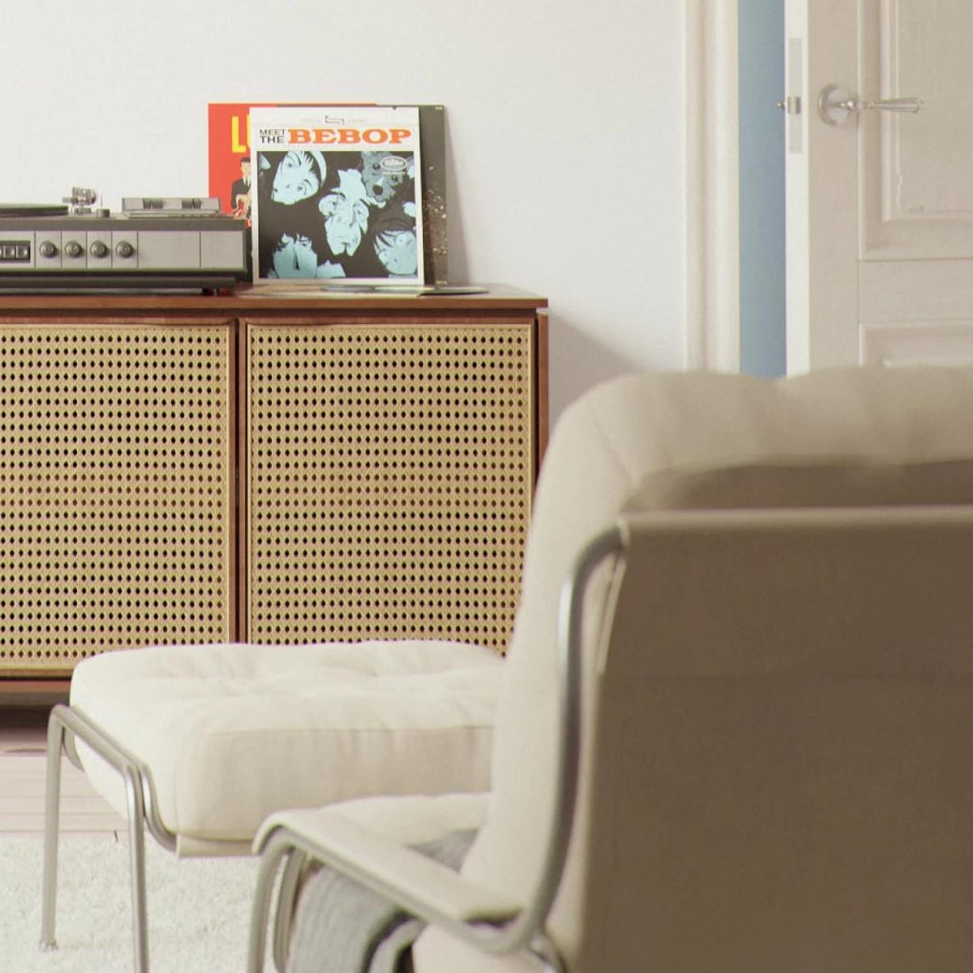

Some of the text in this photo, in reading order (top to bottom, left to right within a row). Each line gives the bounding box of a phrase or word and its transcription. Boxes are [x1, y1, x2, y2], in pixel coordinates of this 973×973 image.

[231, 115, 251, 154] L
[259, 136, 285, 144] THE
[287, 128, 412, 144] BEBOP
